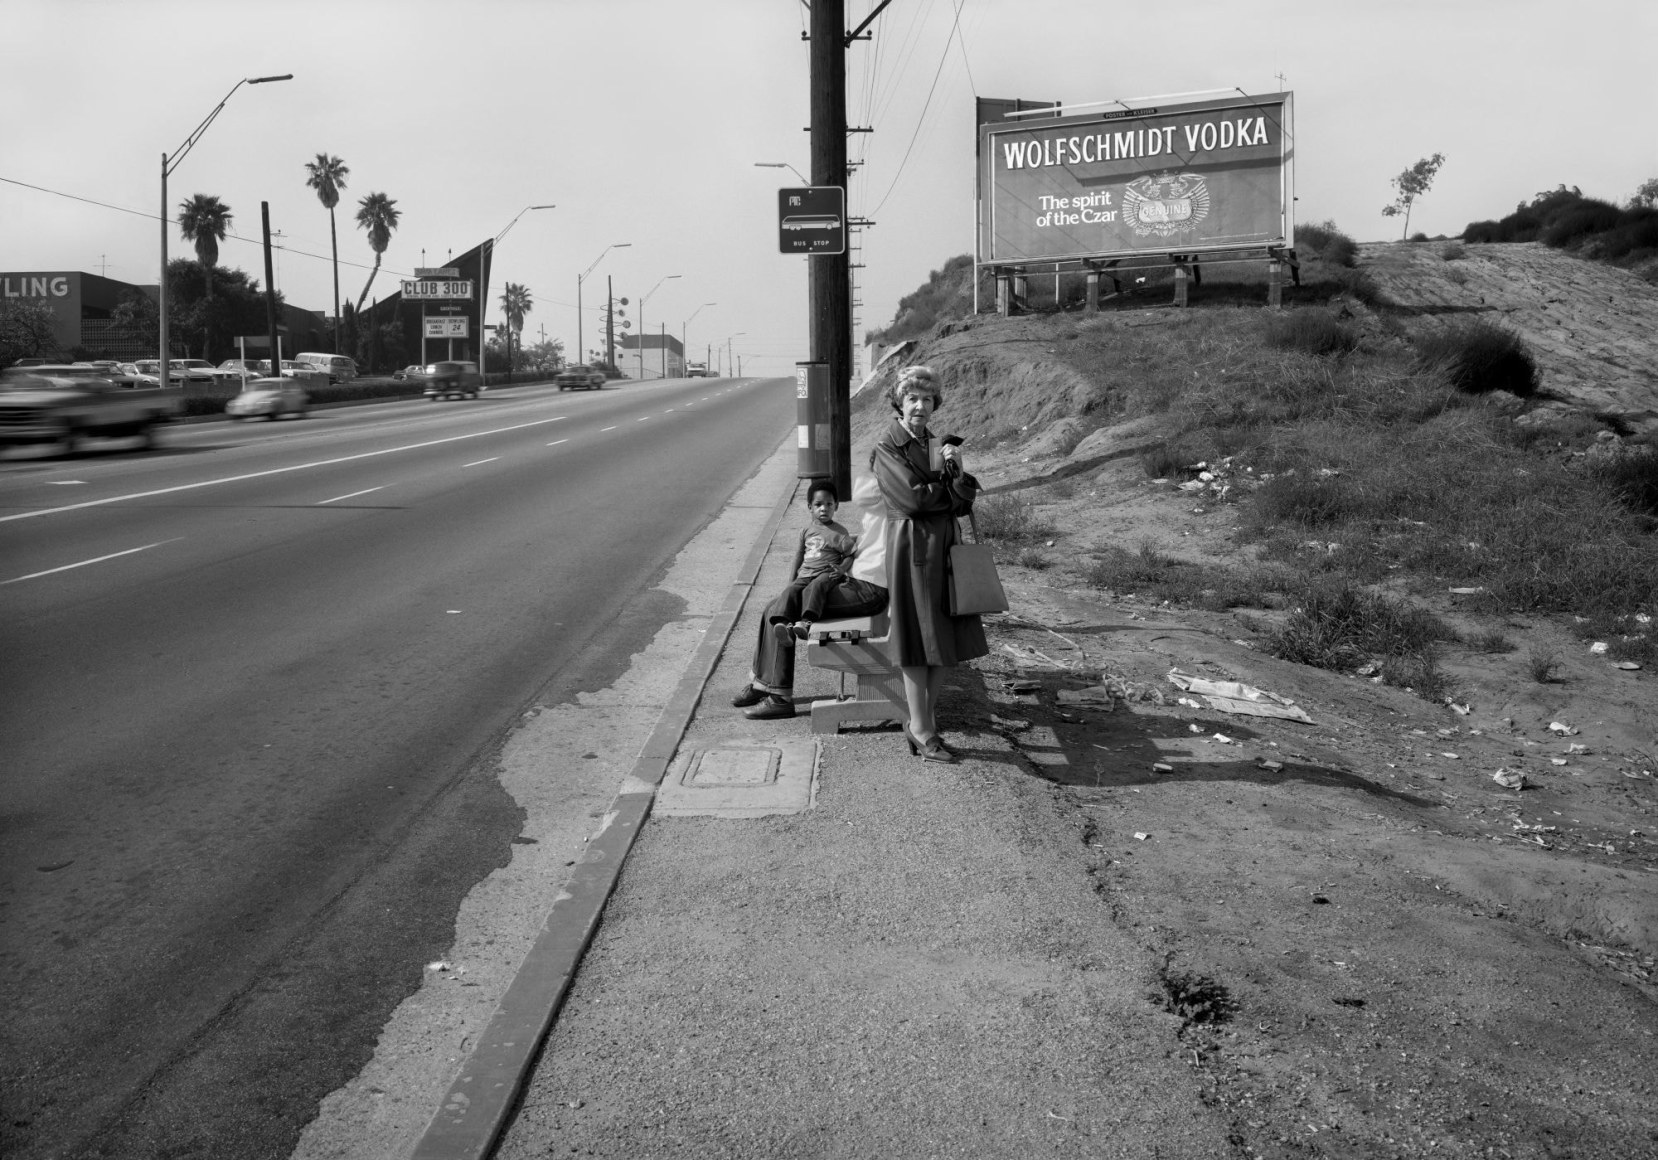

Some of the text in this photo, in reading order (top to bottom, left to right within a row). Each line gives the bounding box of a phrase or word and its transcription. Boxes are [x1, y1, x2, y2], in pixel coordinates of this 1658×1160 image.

[1004, 117, 1269, 169] WOLFSCHMIDT VODKA
[1038, 191, 1111, 211] The spirit
[1142, 203, 1187, 216] GENUINE
[1036, 208, 1118, 228] of the Czar
[0, 276, 68, 297] LING
[405, 283, 467, 294] CLUB 300
